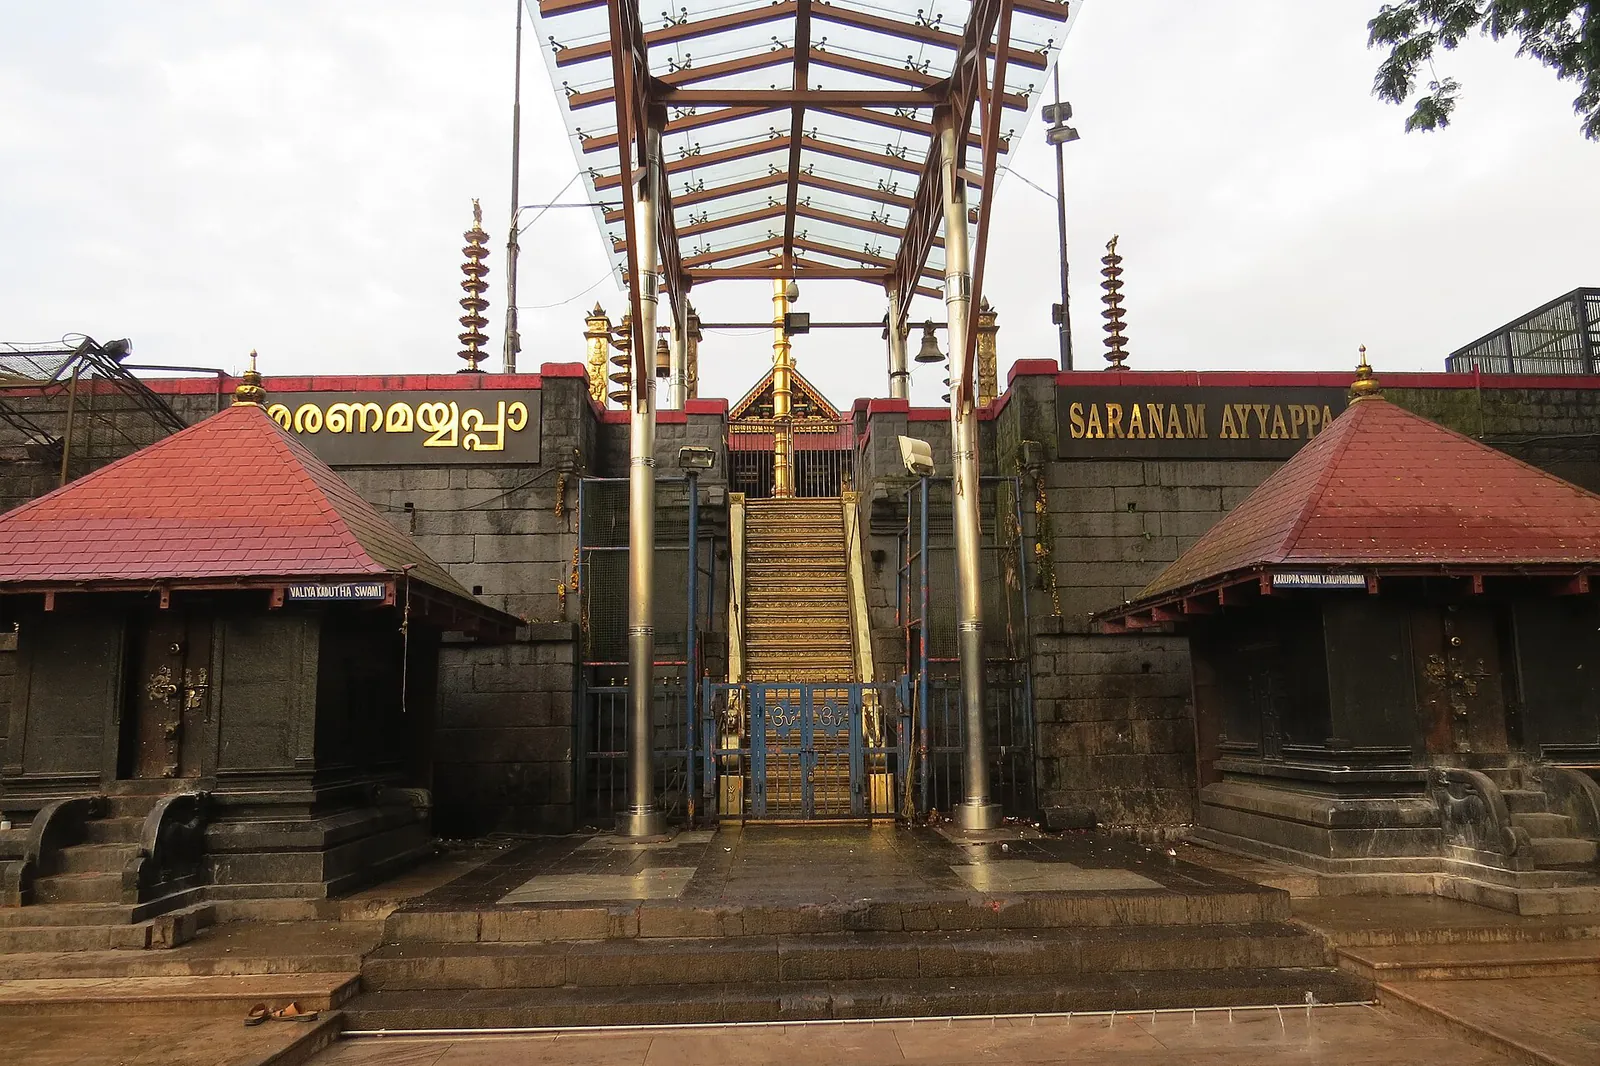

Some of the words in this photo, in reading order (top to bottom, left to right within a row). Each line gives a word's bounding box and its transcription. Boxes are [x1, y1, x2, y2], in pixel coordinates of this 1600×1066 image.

[1069, 402, 1208, 439] SARANAM
[1219, 403, 1333, 439] AYYAPPA
[1273, 574, 1300, 585] KARUPPA
[1300, 574, 1321, 585] SWAMI
[290, 586, 316, 598] VALIYA
[316, 586, 352, 598] KADUTHA
[355, 585, 382, 597] SWAMI
